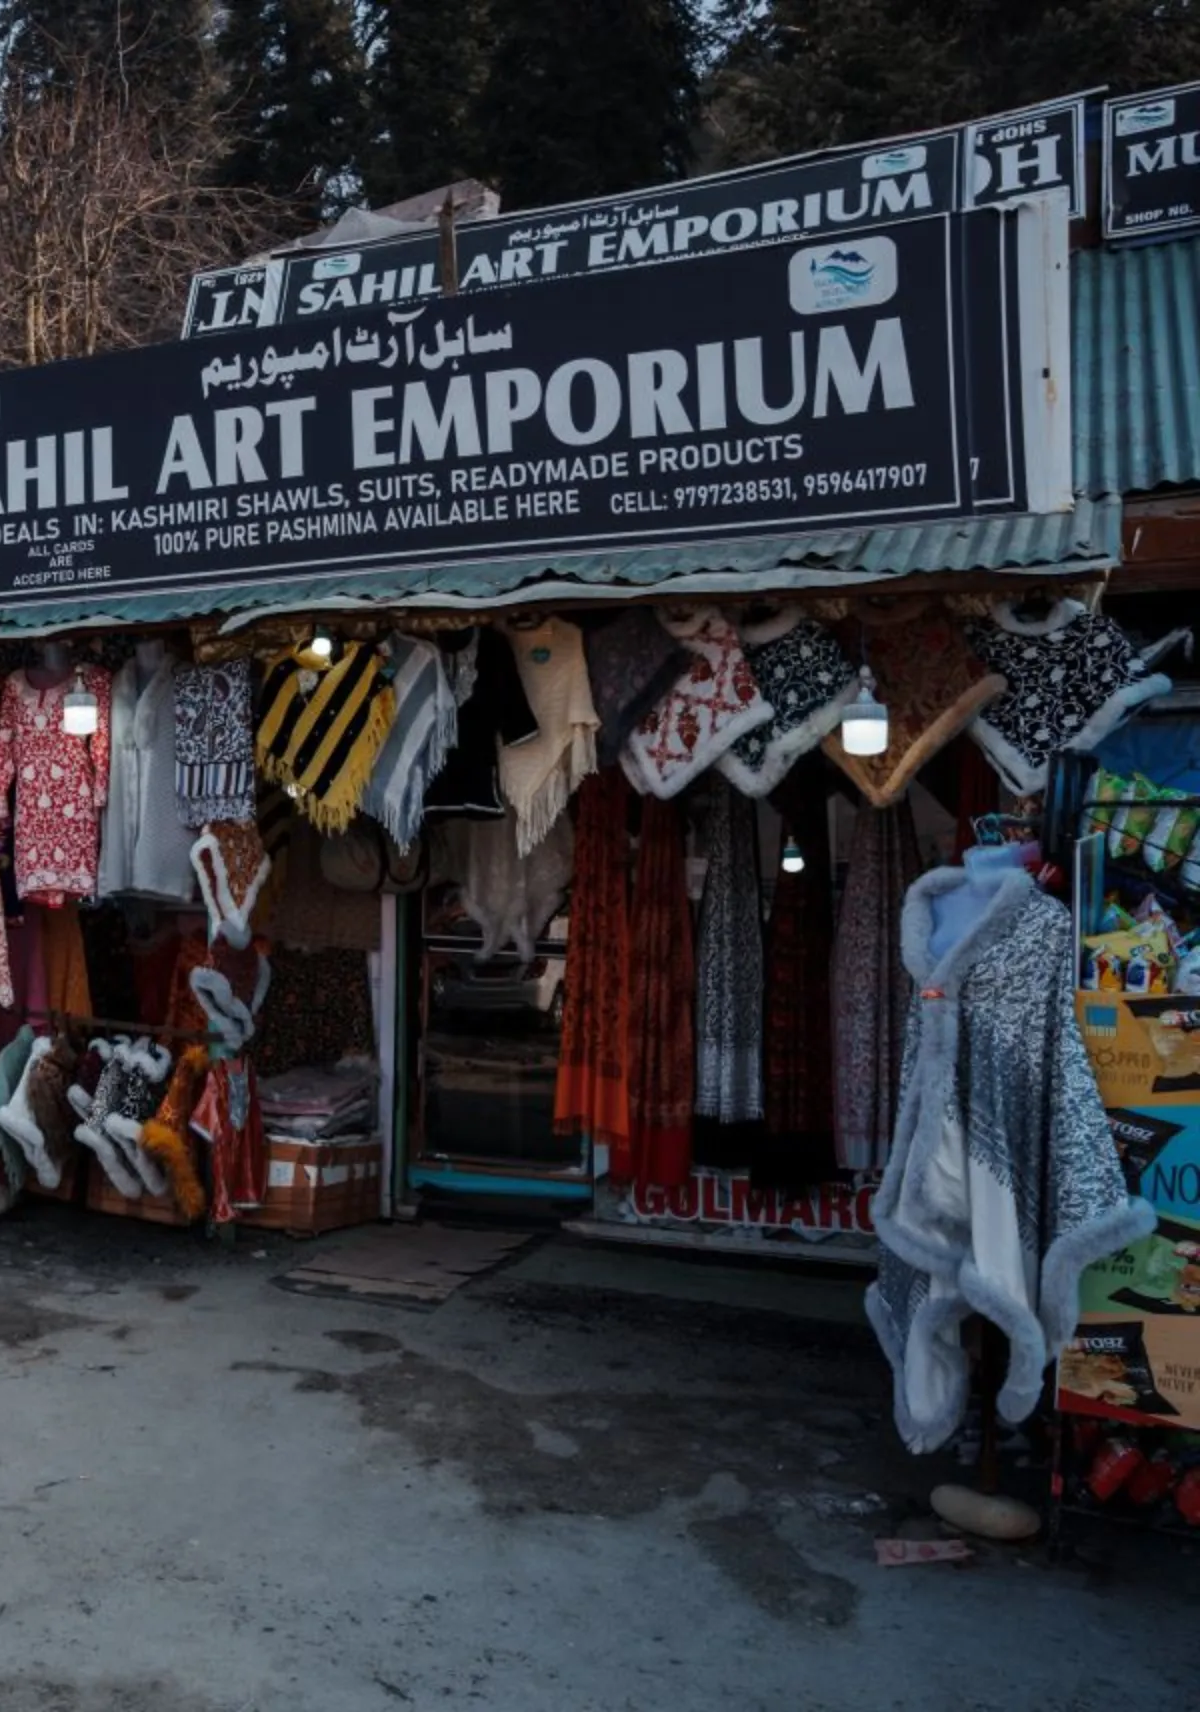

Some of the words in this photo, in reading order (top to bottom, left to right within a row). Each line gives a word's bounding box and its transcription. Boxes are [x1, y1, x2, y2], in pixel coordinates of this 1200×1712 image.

[296, 262, 444, 316] SAHIL
[459, 239, 569, 290] ART
[586, 173, 933, 269] EMPORIUM
[1125, 208, 1164, 226] SHOP
[155, 396, 317, 496] ART
[350, 316, 916, 473] EMPORIUM
[74, 514, 104, 536] IN:
[110, 497, 229, 533] KASHMIRI
[236, 483, 350, 519] SHAWLS,
[358, 472, 444, 504] SUITS,
[451, 452, 630, 493] READYMADE
[639, 434, 804, 473] PRODUCTS
[153, 531, 200, 557] 100%
[205, 525, 261, 551] PURE
[266, 513, 378, 546] PASHMINA
[397, 498, 508, 530] AVAILABLE
[517, 489, 581, 519] HERE
[610, 485, 668, 515] CELL:
[803, 463, 928, 498] 9596417907
[13, 569, 75, 588] ACCEPTED
[78, 566, 112, 581] HERE
[28, 545, 52, 559] ALL
[54, 540, 95, 555] CARDS
[49, 556, 74, 569] ARE
